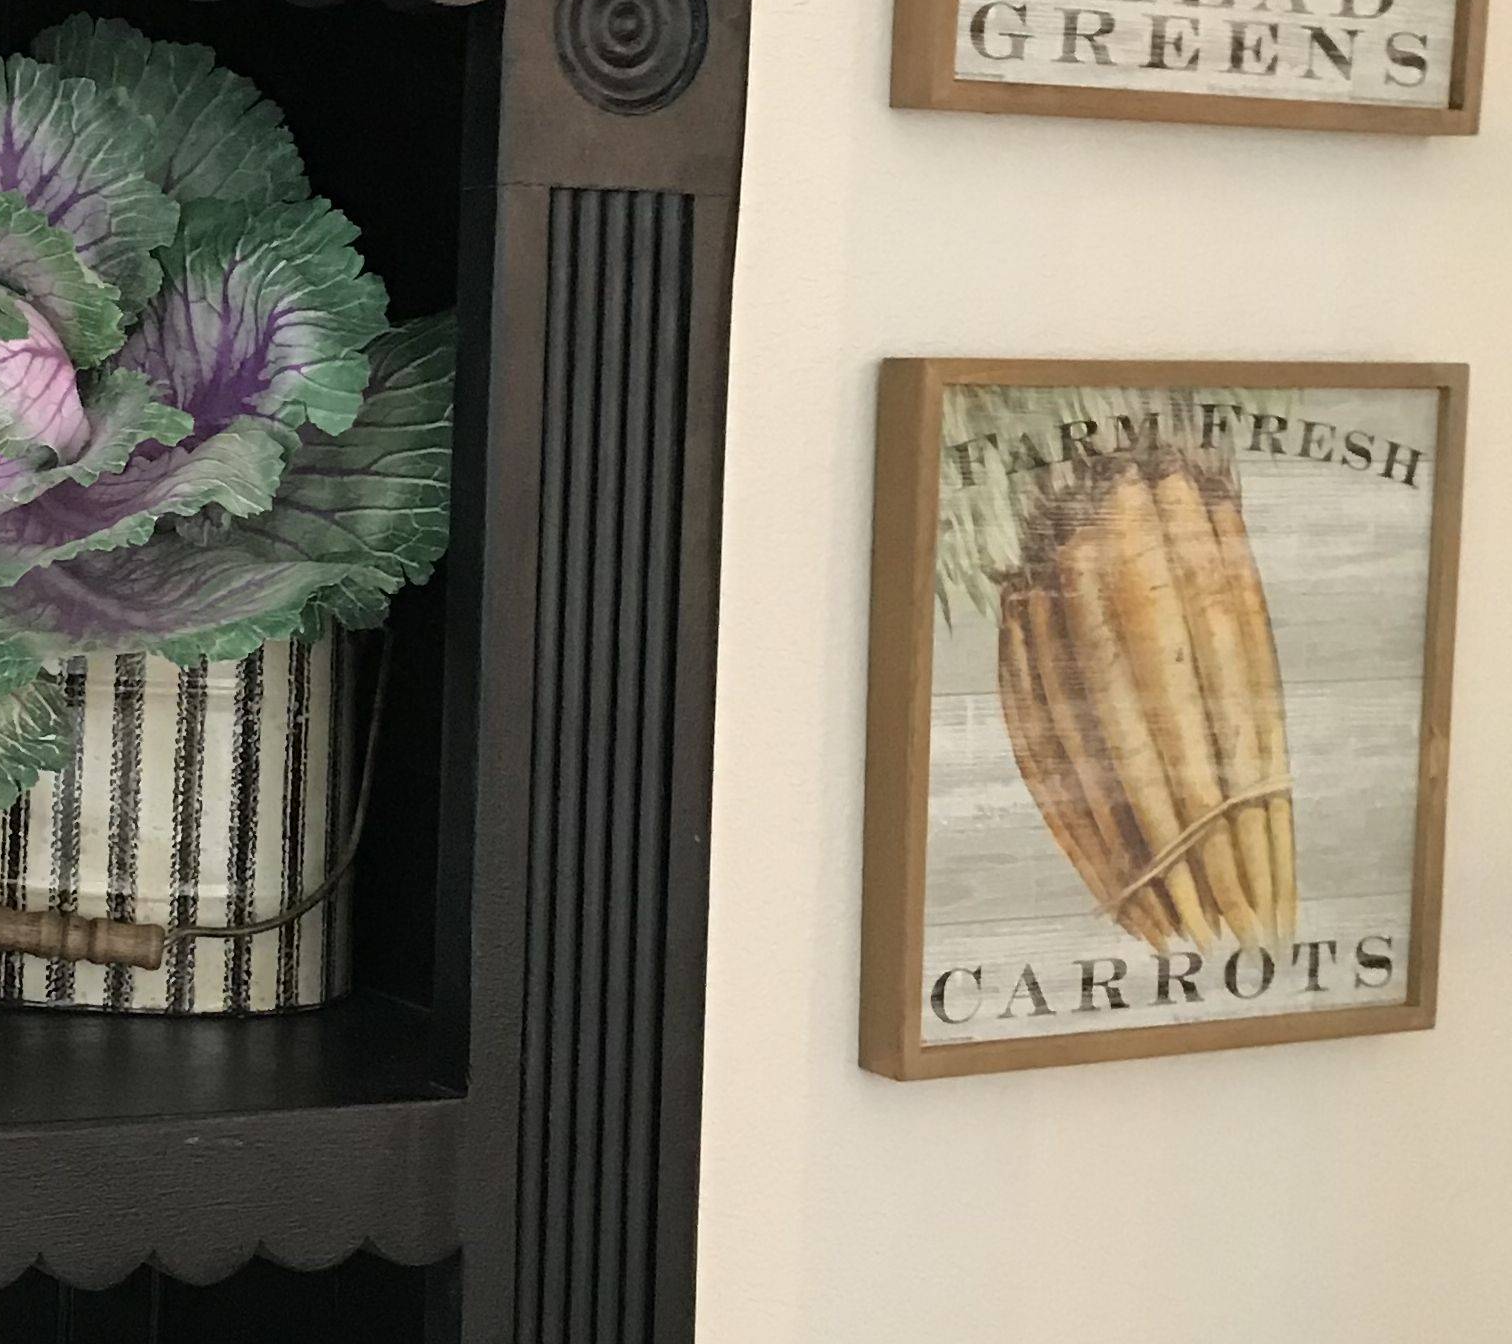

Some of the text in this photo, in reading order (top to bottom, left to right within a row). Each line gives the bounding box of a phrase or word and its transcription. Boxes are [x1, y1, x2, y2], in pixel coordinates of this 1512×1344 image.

[968, 0, 1429, 88] GREENS
[950, 402, 1427, 491] FARM FRESH
[930, 936, 1394, 1025] CARROTS
